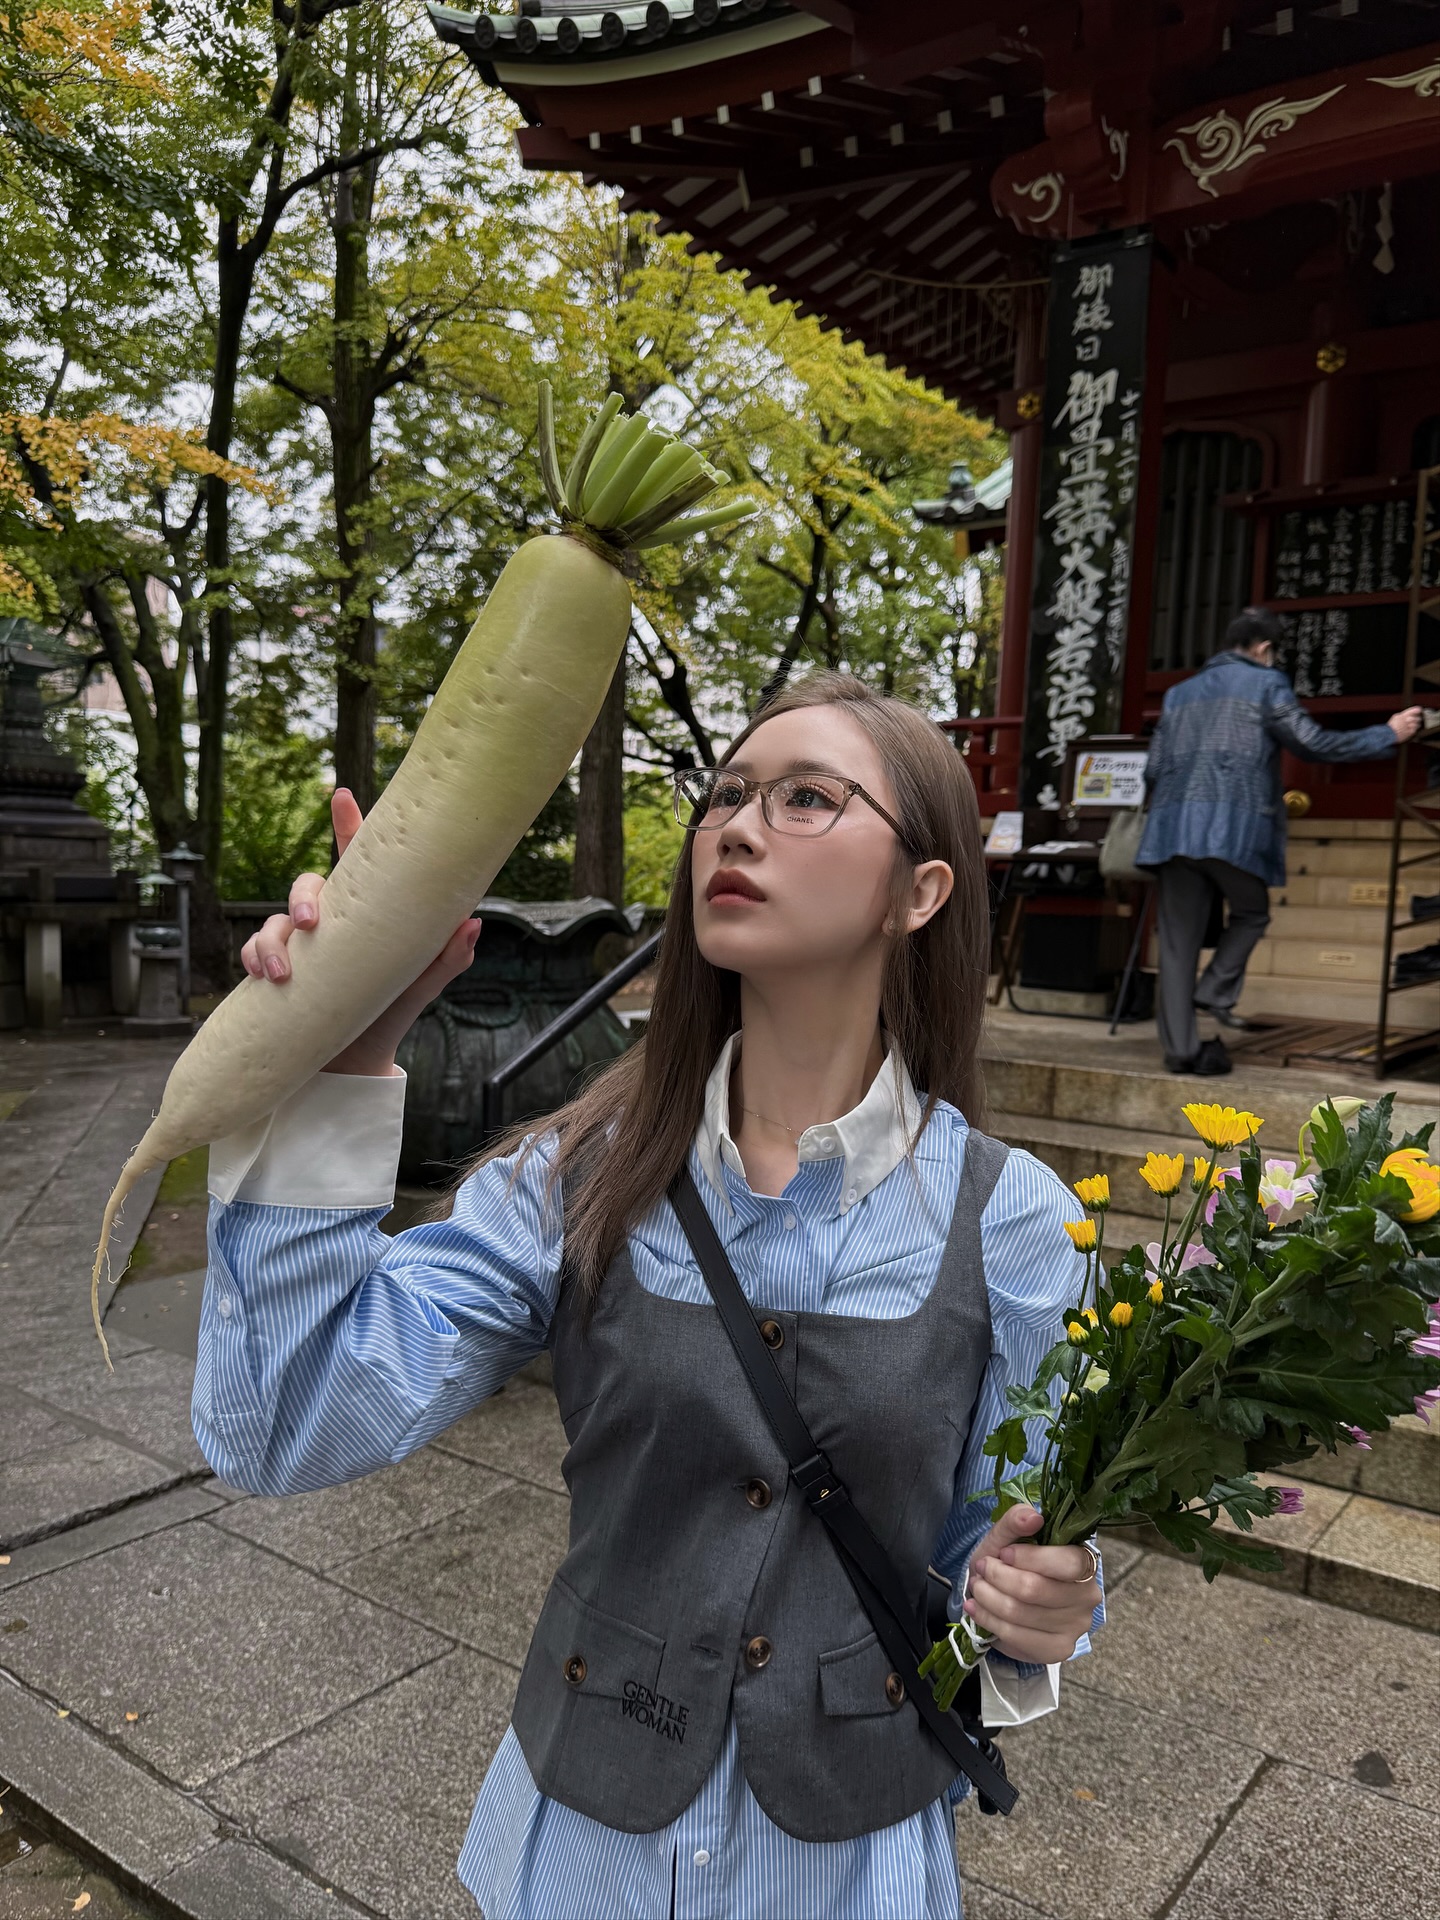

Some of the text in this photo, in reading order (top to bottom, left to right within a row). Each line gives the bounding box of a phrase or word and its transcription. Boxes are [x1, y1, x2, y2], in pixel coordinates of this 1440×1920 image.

[787, 816, 814, 825] CHANEL
[622, 1698, 686, 1744] WOMAN
[623, 1680, 689, 1725] GENTLE
